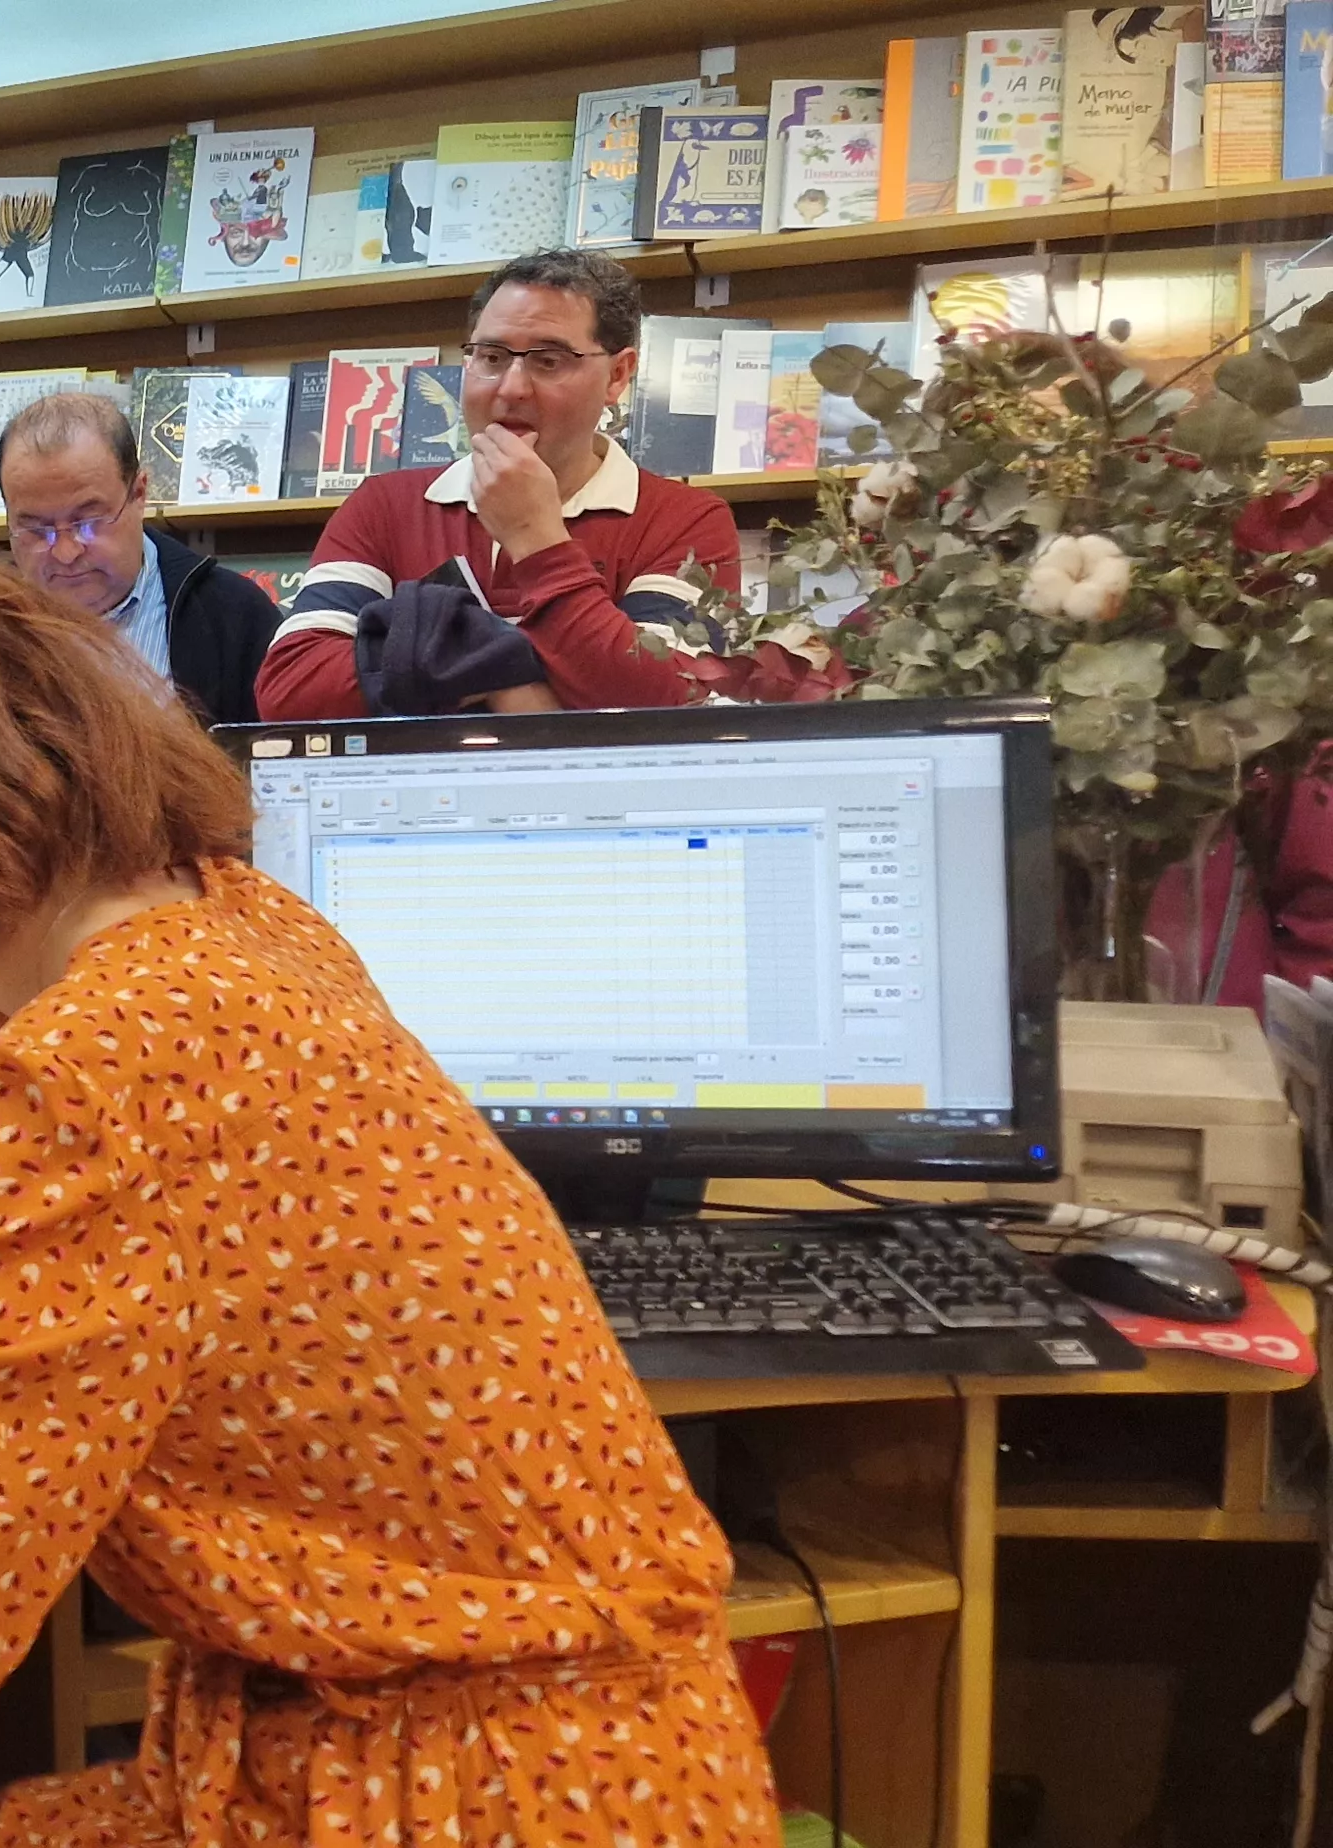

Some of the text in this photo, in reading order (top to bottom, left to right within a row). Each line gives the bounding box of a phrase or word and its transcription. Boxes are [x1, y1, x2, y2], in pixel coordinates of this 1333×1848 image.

[1078, 84, 1132, 104] Mano
[1084, 103, 1153, 121] de mujer
[210, 149, 299, 163] UN DÍA EN MI CABEZA
[729, 149, 766, 166] DIBU
[727, 170, 744, 185] ES
[804, 167, 878, 180] Ilustración
[103, 282, 142, 295] KATIA
[735, 361, 759, 370] Kafka
[324, 476, 358, 488] SEÑOR
[1154, 1330, 1300, 1361] CGT
